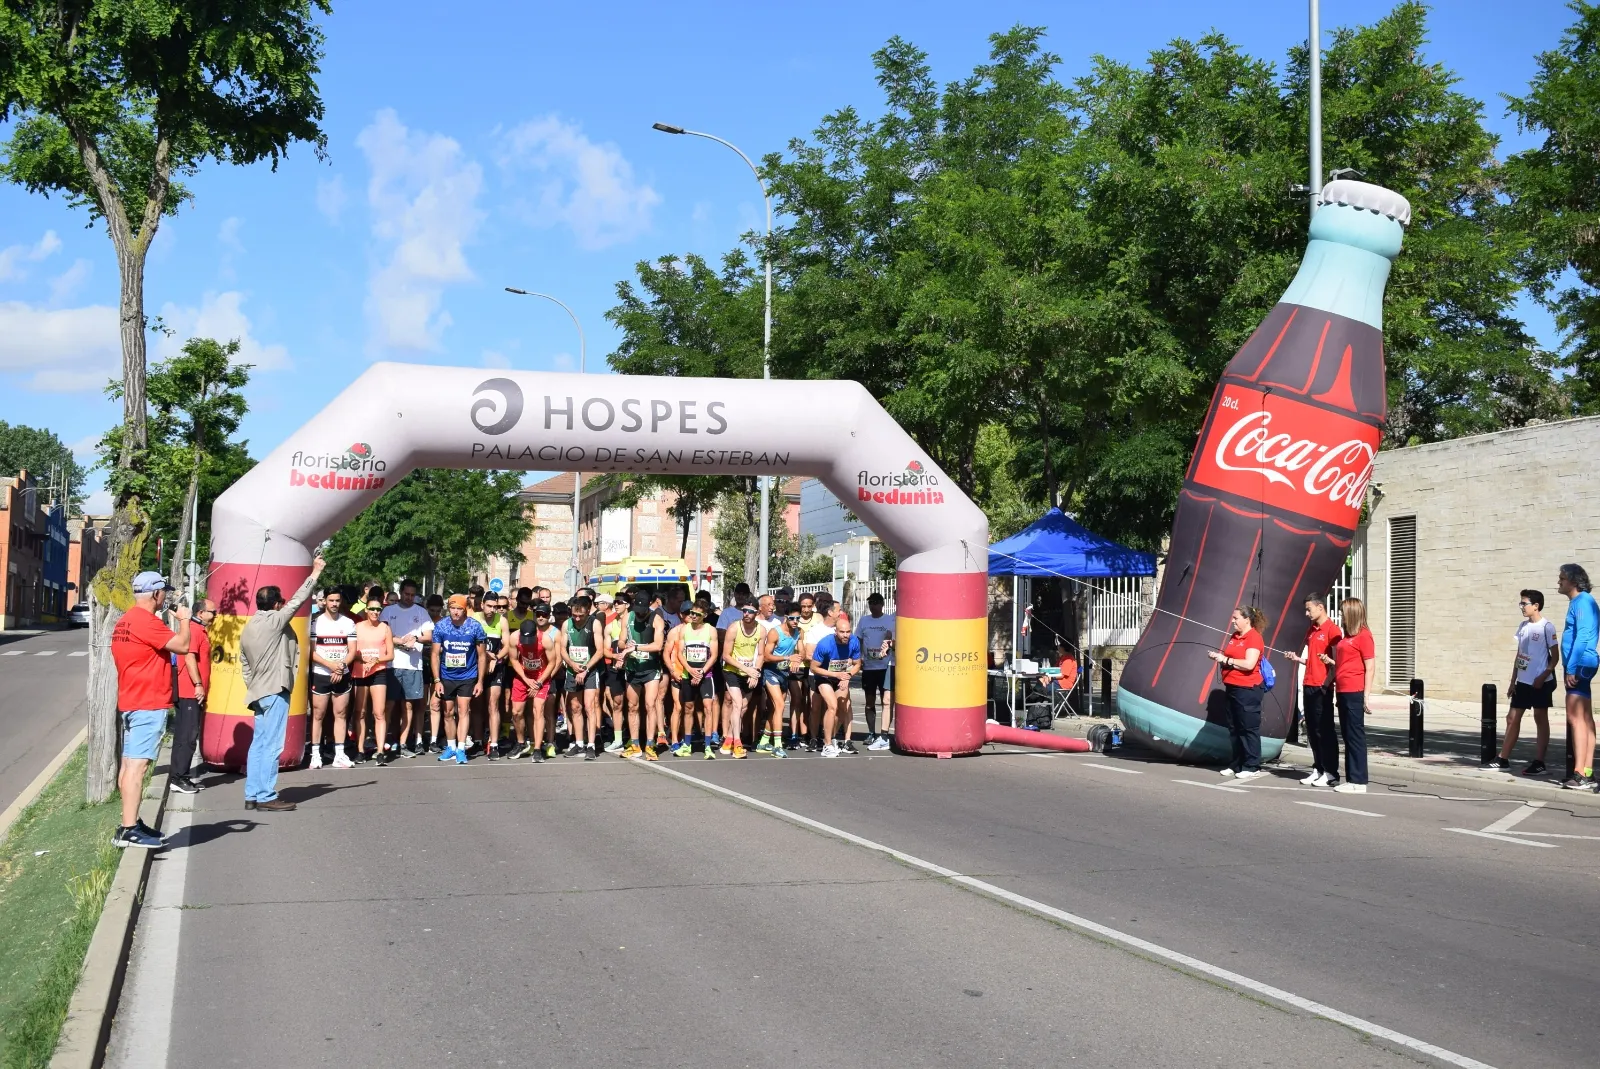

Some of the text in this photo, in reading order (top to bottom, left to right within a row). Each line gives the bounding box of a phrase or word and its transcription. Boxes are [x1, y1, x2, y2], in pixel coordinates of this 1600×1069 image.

[1222, 396, 1232, 408] 20
[543, 396, 728, 435] HOSPES
[291, 451, 387, 472] floristería
[471, 443, 790, 466] PALACIO DE SAN ESTEBAN
[289, 469, 386, 491] bedunia
[857, 470, 939, 487] floristería
[858, 487, 945, 505] bedunia
[933, 651, 979, 663] HOSPES
